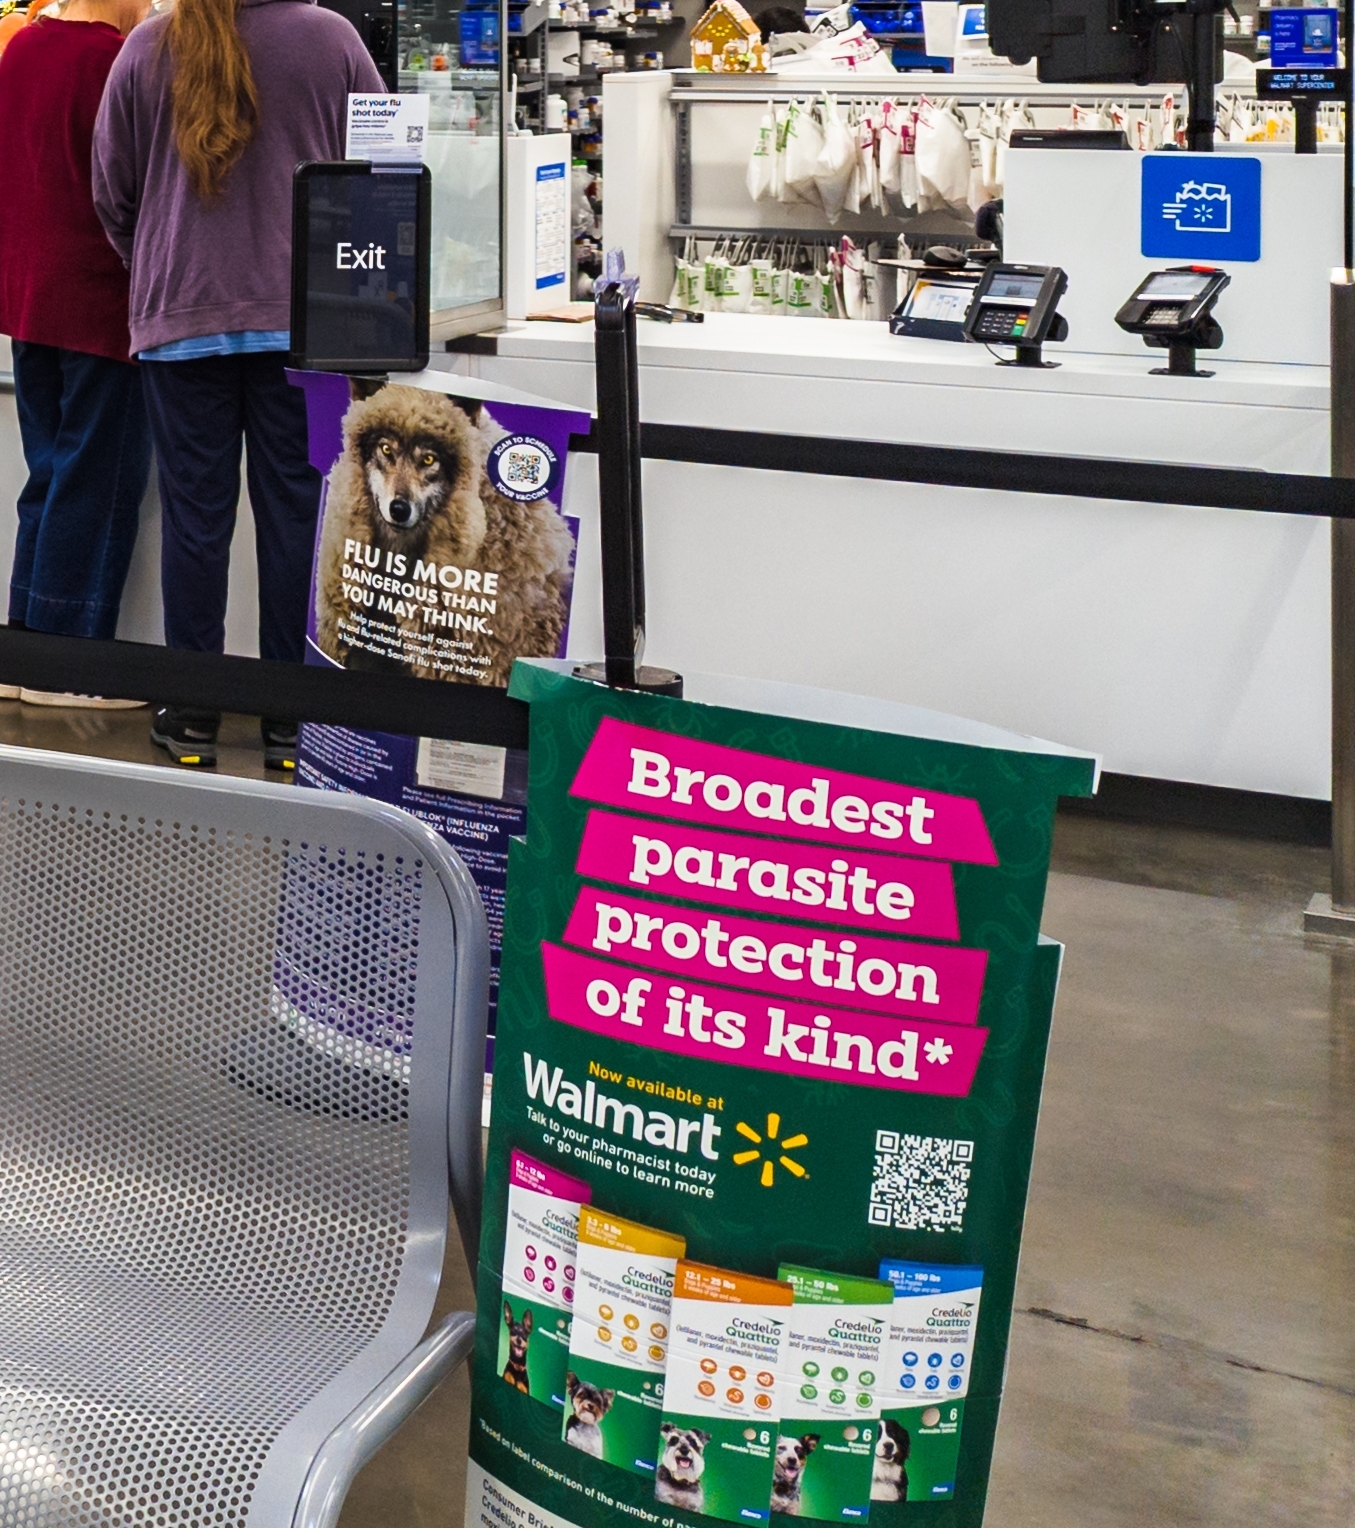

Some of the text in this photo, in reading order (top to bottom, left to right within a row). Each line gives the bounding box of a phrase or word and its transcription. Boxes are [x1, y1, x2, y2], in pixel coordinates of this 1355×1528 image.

[351, 109, 371, 117] shot
[352, 98, 402, 107] Get your flu
[336, 242, 387, 270] Exit
[342, 563, 497, 614] DANGEROUS THAN
[343, 538, 499, 596] FLU IS MORE
[342, 581, 494, 636] YOU MAY THINK.
[626, 747, 935, 845] Broadest
[628, 833, 916, 921] parasite
[591, 902, 941, 1005] protection
[585, 977, 653, 1027] of
[663, 987, 747, 1048] its
[523, 1051, 722, 1161] Walmart
[588, 1060, 725, 1111] Now available at
[526, 1105, 717, 1186] Talk to your pharmacist today
[726, 1327, 780, 1345] Quattro
[732, 1318, 781, 1335] Credelio
